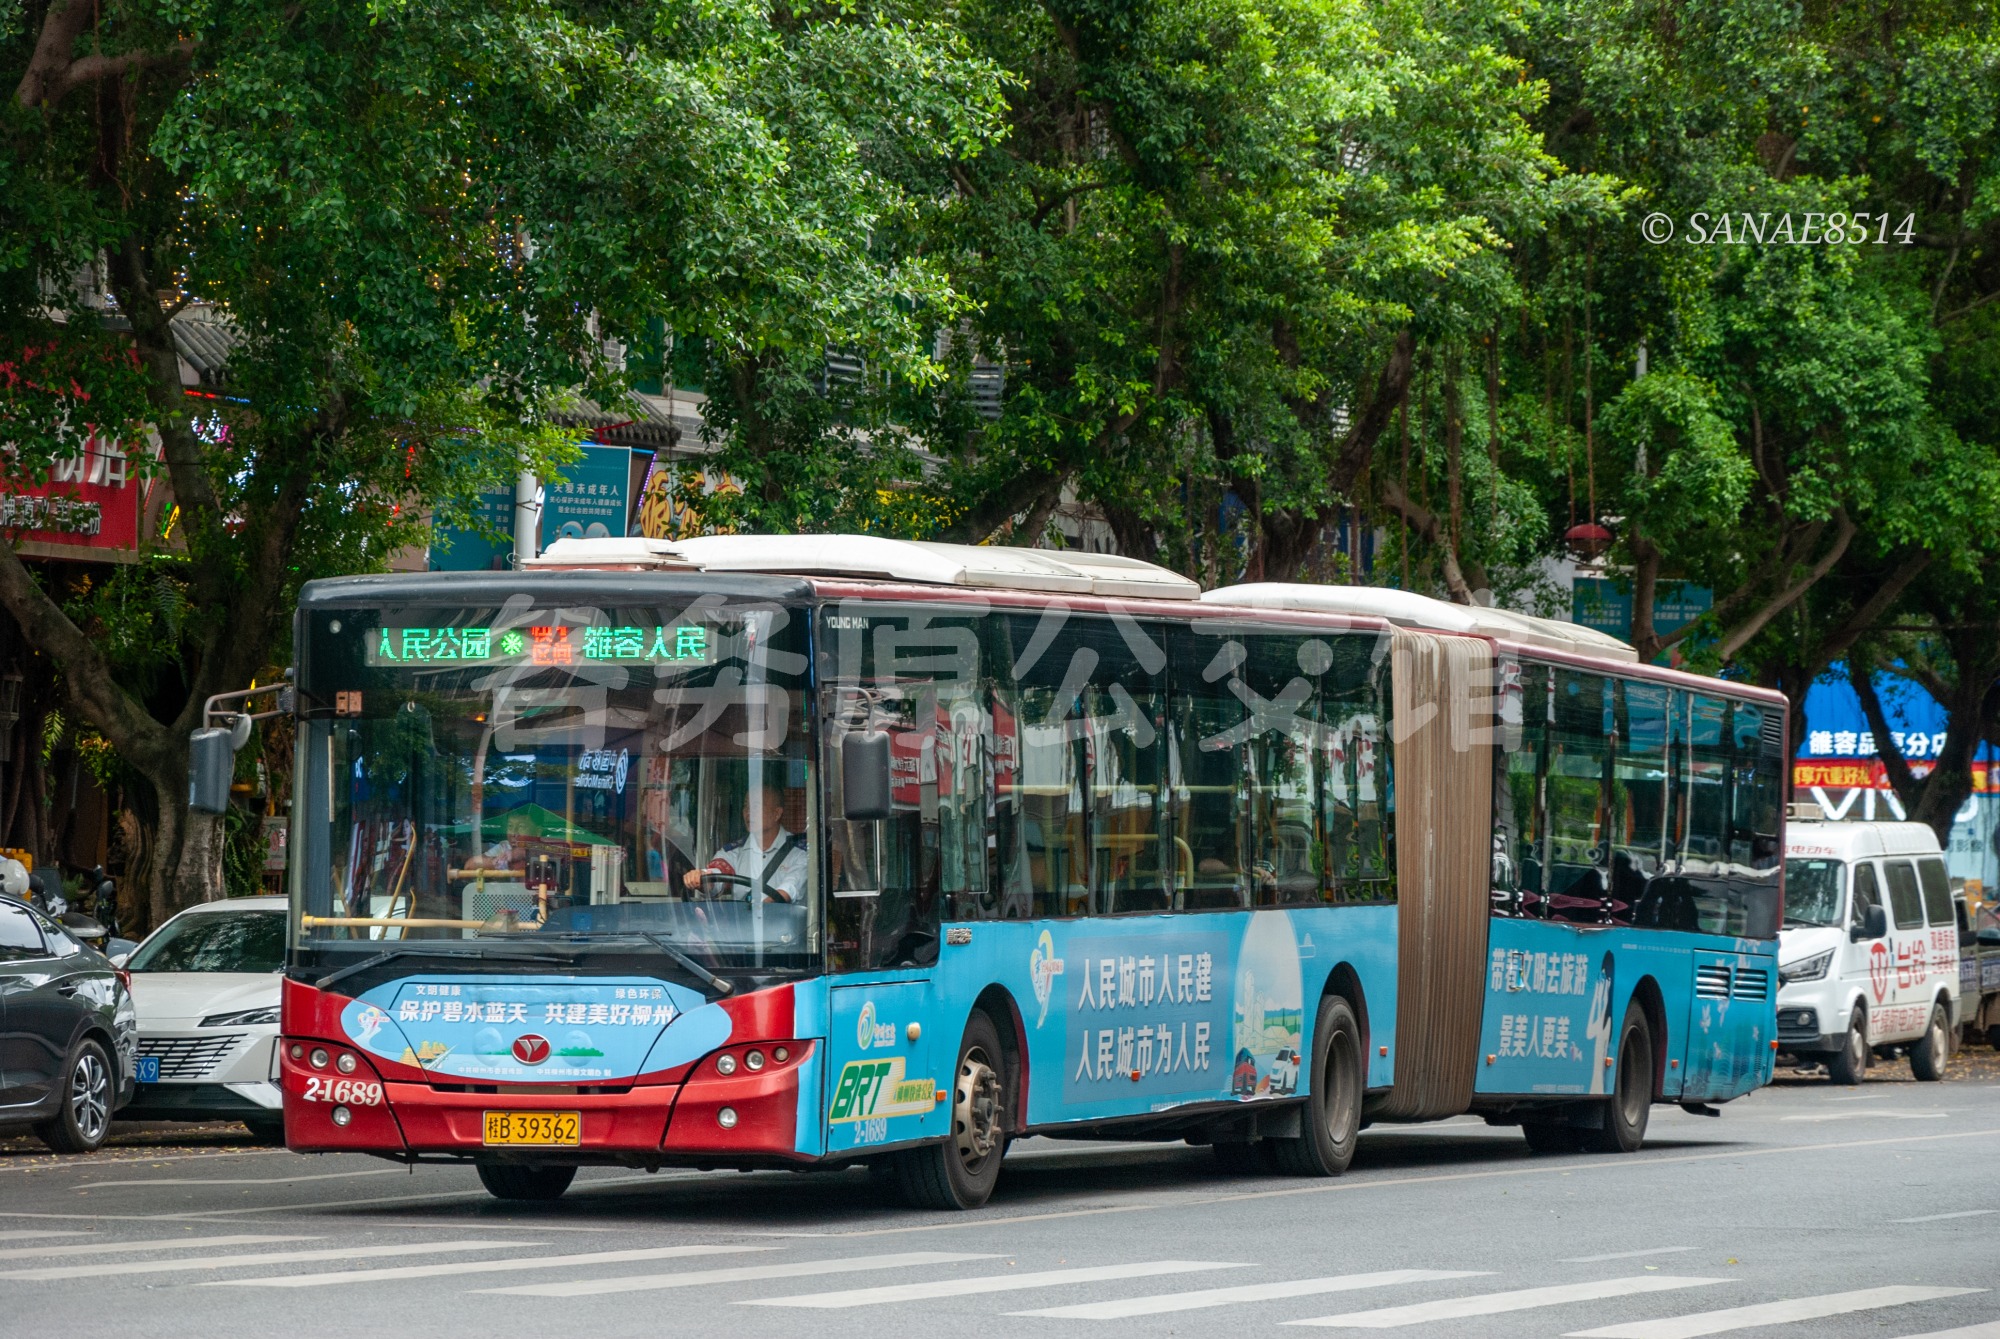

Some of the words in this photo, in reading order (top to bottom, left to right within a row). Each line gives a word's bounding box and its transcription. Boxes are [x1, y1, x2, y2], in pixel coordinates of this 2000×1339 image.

[549, 496, 623, 507] 关心保护未成年人健康成长
[554, 482, 619, 496] 关爱未成年人
[558, 505, 613, 516] 是全社会的共同责任
[826, 615, 851, 629] YOUNG
[852, 616, 869, 629] MAN
[379, 627, 491, 662] 人民公园
[582, 627, 706, 661] 雒容人民
[1078, 952, 1212, 1012] 人民城市人民建
[1491, 948, 1589, 996] 带着文明去旅游
[416, 985, 462, 996] 文明健康
[615, 988, 662, 1000] 绿色环保
[400, 1000, 528, 1024] 保护碧水蓝天
[544, 1003, 675, 1027] 共建美好柳州
[1498, 1014, 1571, 1059] 景美人更美
[1075, 1021, 1211, 1083] 人民城市为人民
[303, 1077, 383, 1107] 2-1689
[830, 1062, 892, 1119] BRT
